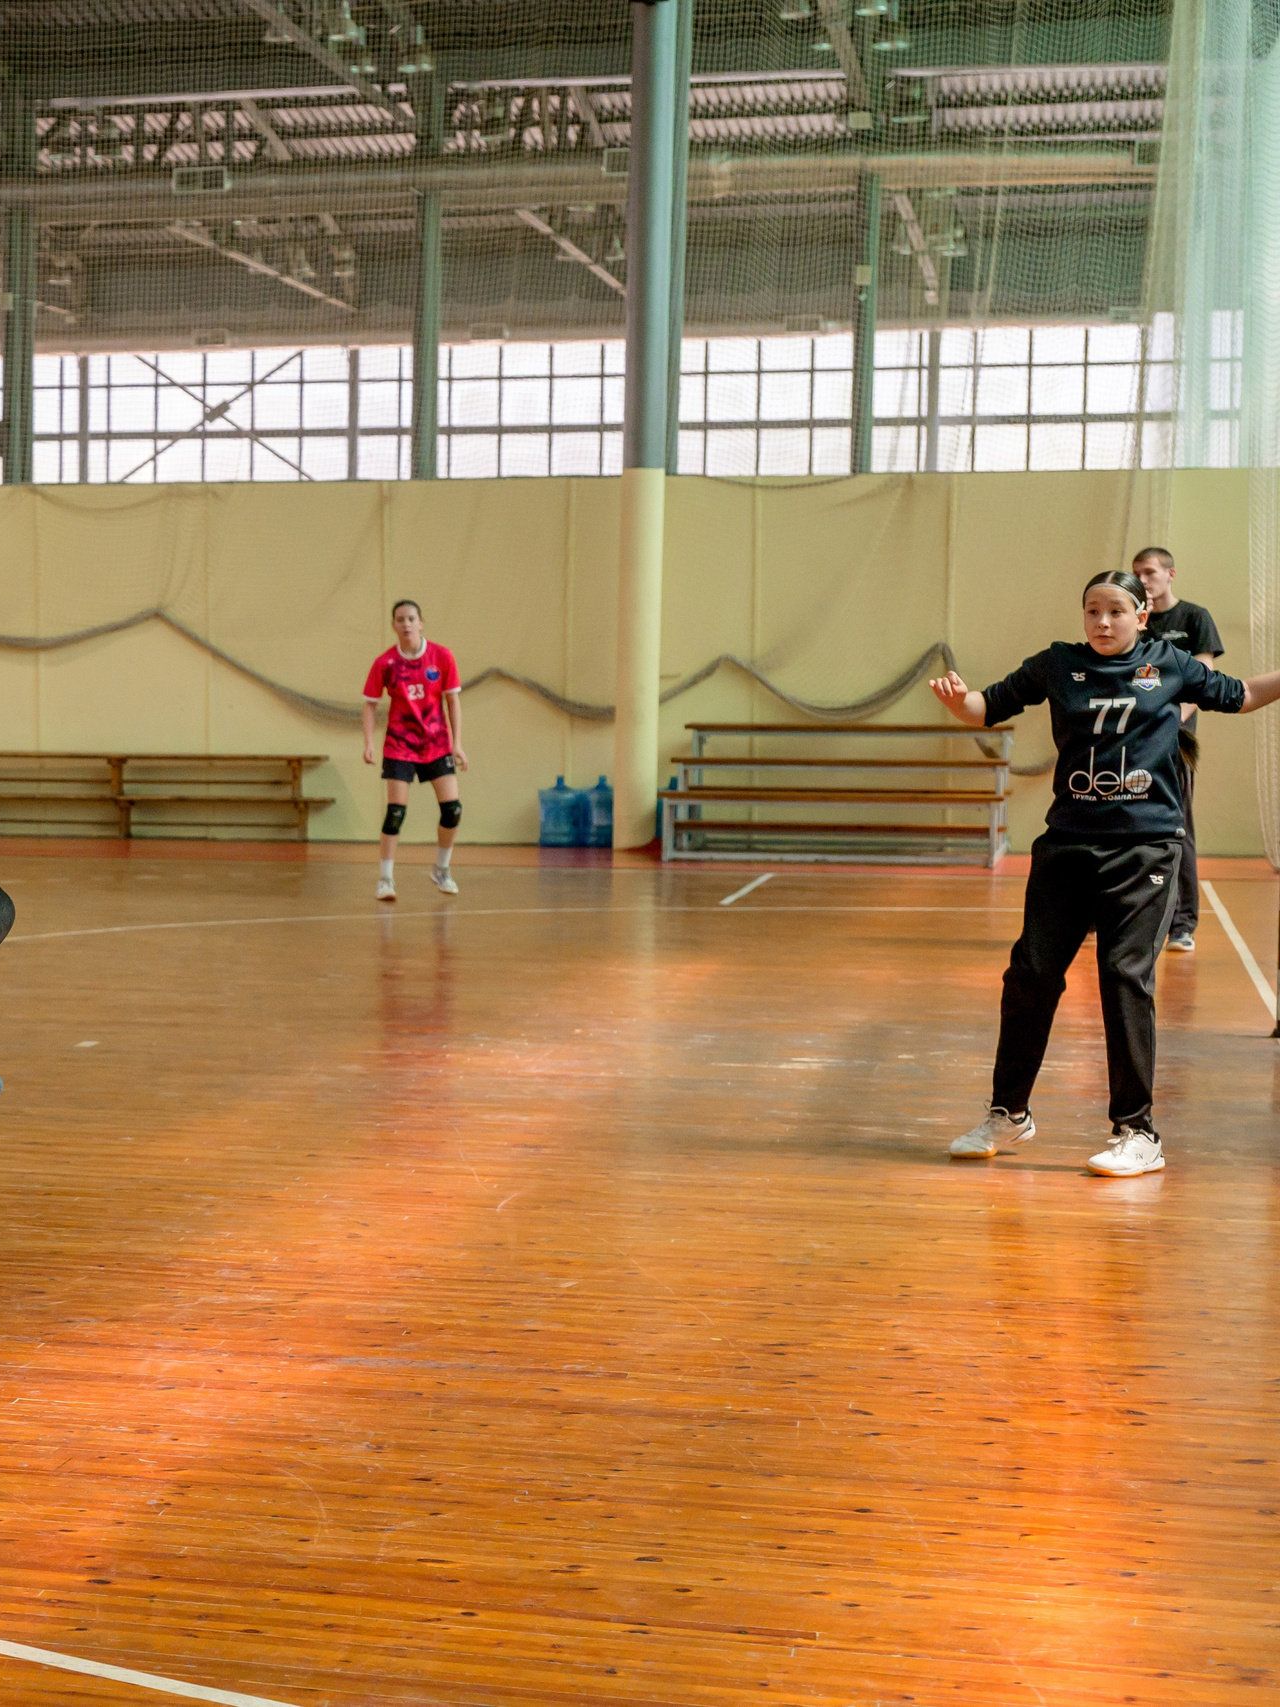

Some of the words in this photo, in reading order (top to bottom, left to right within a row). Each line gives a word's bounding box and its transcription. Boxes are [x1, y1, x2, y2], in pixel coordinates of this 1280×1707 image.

[407, 683, 425, 700] 23
[1089, 697, 1137, 735] 77
[1068, 746, 1153, 796] delo
